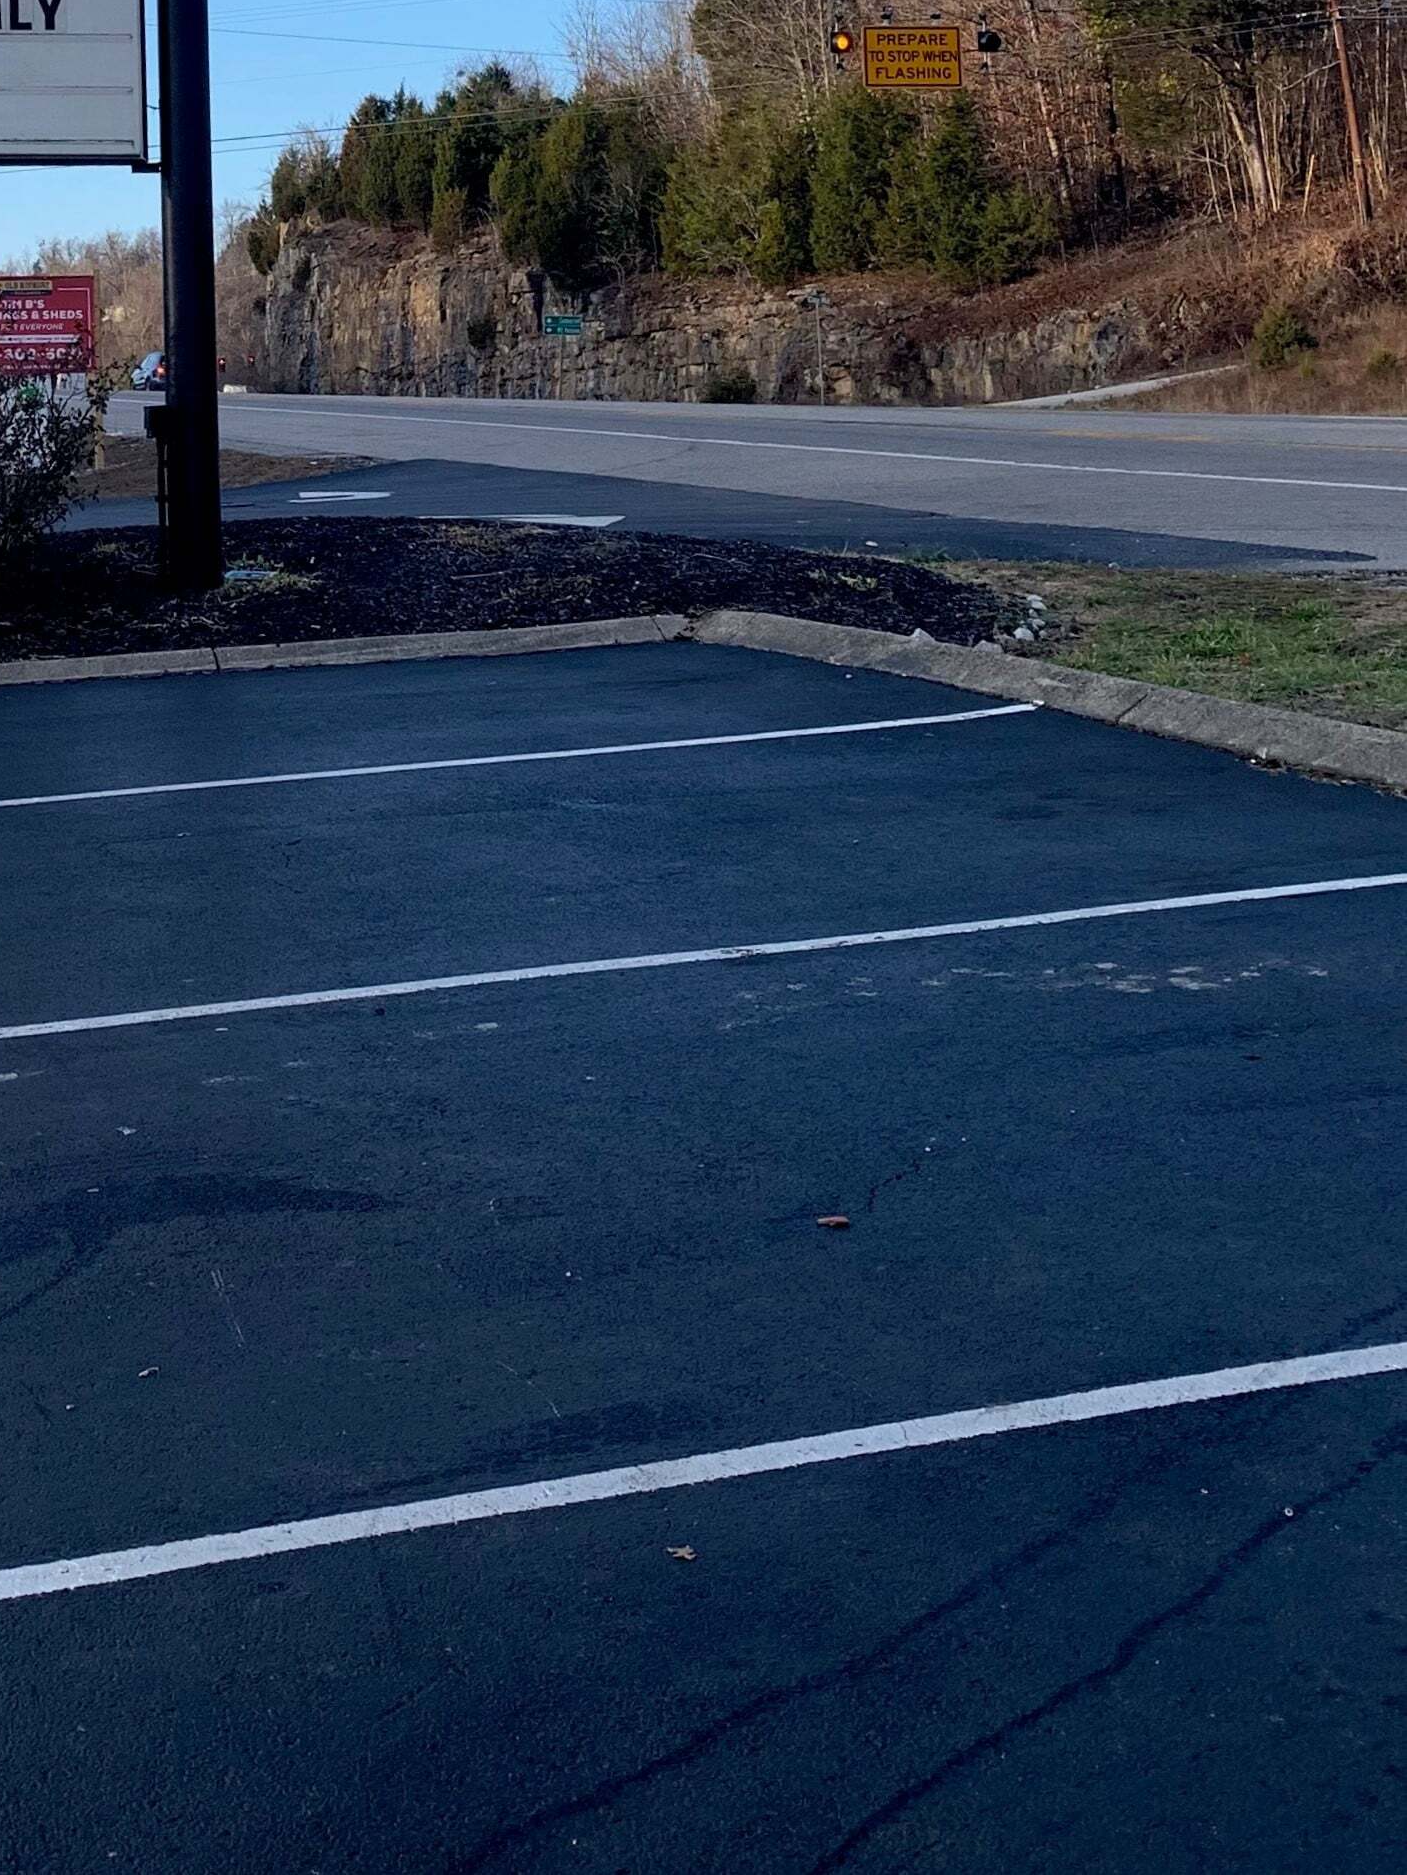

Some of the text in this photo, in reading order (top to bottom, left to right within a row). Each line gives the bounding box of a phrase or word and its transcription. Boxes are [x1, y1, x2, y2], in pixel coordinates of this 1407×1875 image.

[876, 33, 948, 46] PREPARE
[868, 50, 959, 63] TO STOP WHEN
[875, 67, 952, 80] FLASHING
[42, 309, 84, 320] SHEDS
